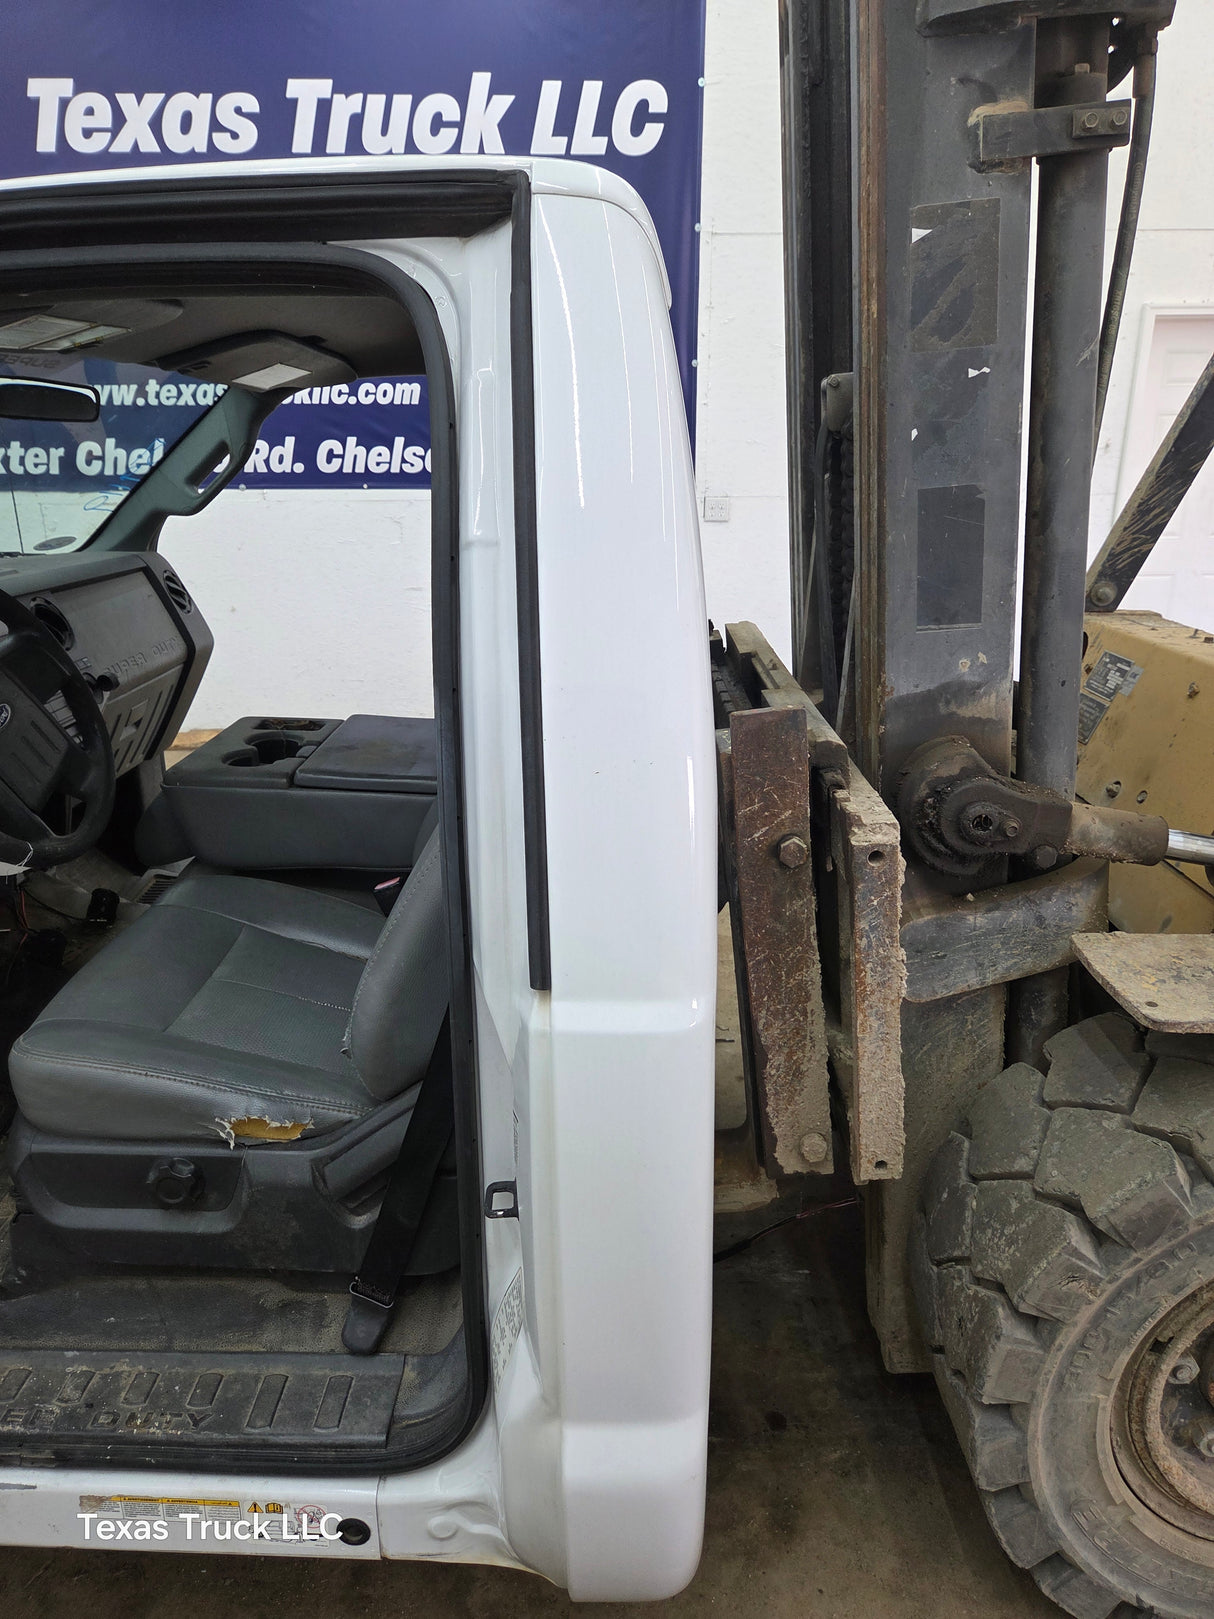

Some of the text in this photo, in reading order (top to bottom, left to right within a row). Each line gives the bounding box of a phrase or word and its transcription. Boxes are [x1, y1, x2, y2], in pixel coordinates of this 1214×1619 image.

[26, 71, 668, 156] Texas Truck LLC
[243, 436, 305, 473] Rd.
[89, 1410, 214, 1429] DUTY
